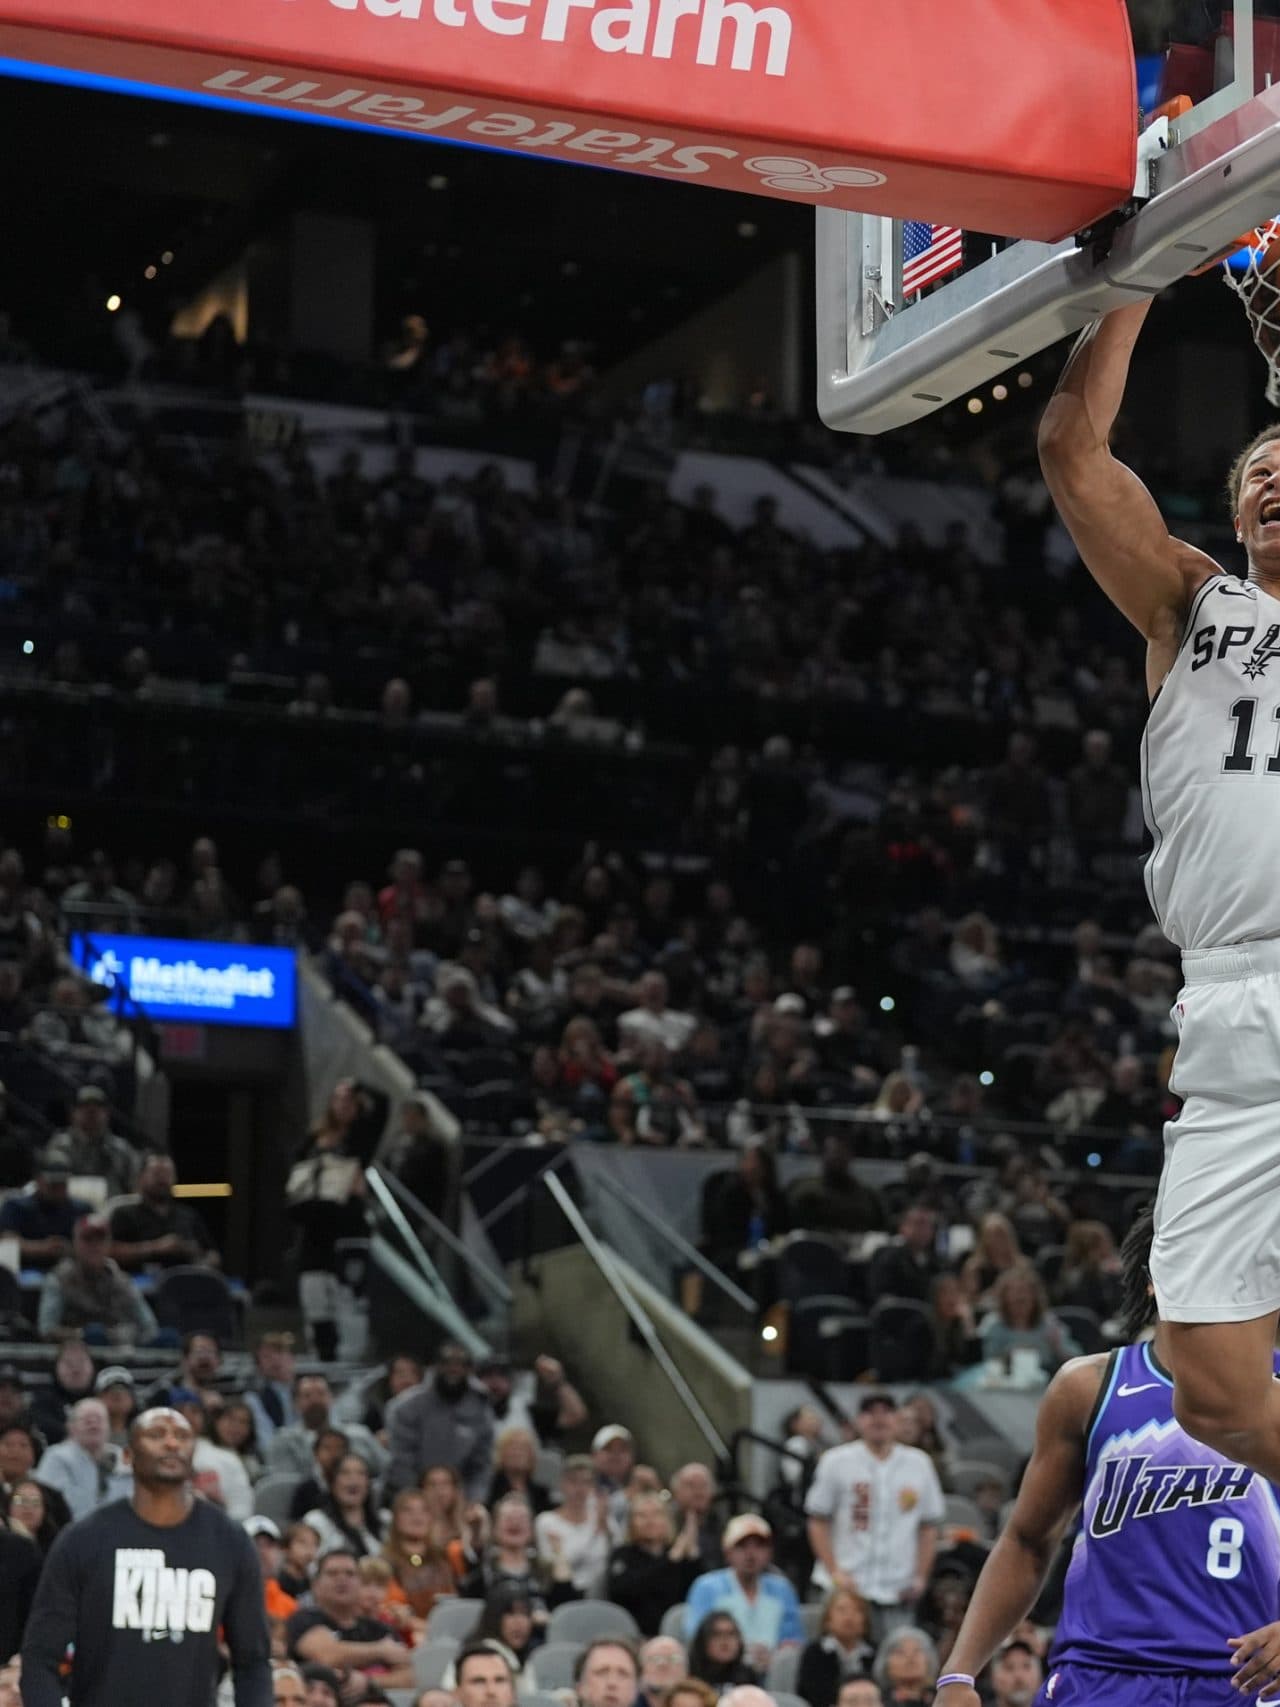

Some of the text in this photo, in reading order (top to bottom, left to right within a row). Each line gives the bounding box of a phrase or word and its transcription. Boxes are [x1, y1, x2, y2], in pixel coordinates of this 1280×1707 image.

[130, 957, 275, 998] Methodist
[1206, 1517, 1244, 1580] 8
[112, 1567, 217, 1632] KING
